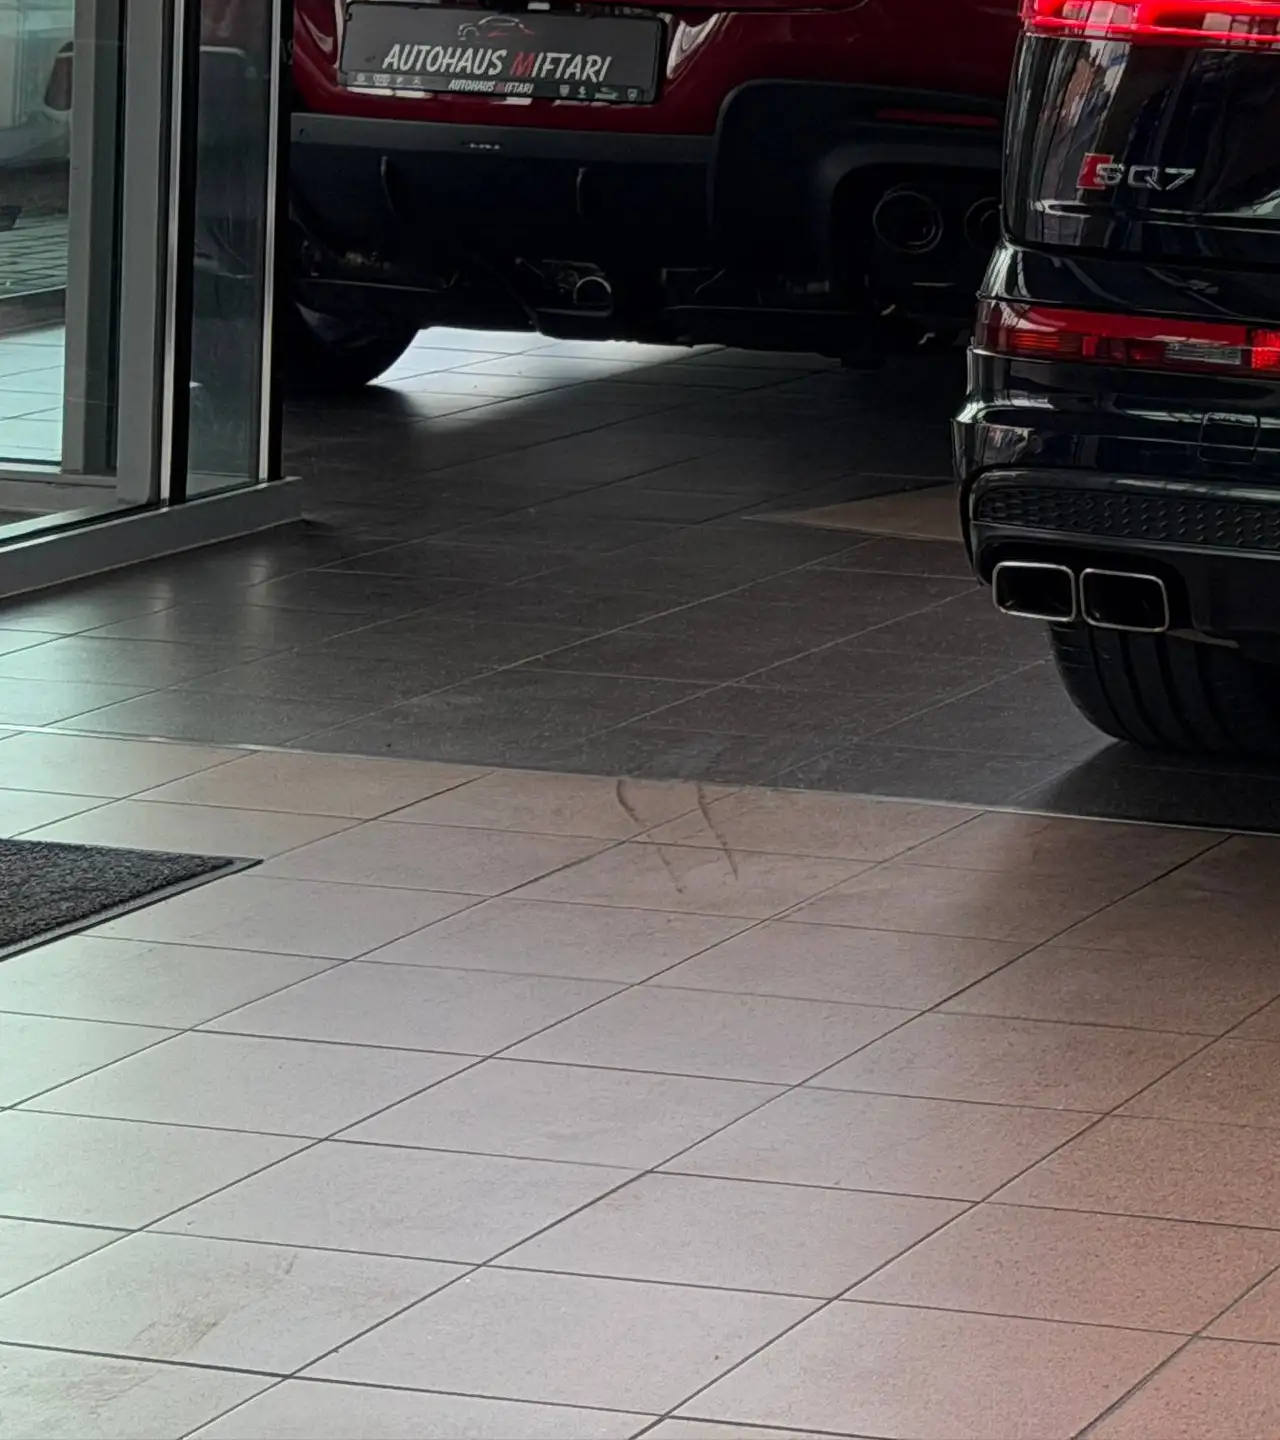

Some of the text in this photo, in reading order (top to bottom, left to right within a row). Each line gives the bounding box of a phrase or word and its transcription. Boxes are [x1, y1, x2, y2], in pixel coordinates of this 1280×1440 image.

[382, 43, 612, 83] AUTOHAUS MIFTARI
[448, 79, 495, 92] AUTOHAUS
[1093, 162, 1197, 192] SQ7
